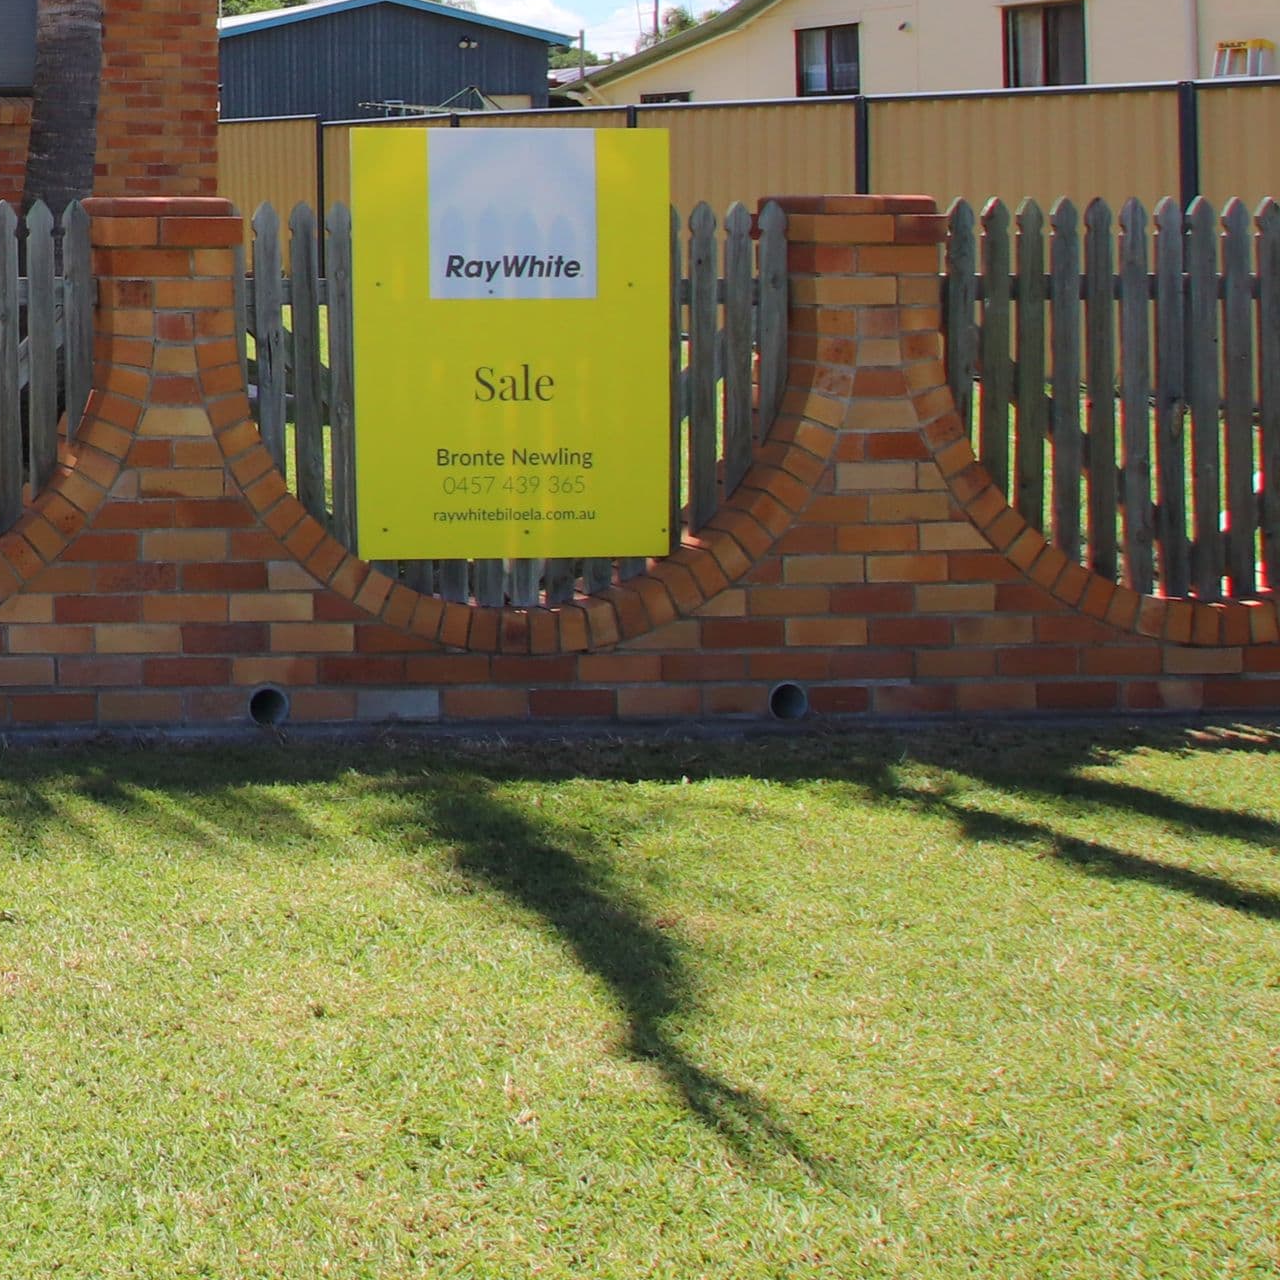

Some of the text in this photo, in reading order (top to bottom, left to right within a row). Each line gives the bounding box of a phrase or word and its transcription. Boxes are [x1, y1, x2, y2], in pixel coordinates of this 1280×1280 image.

[474, 364, 555, 402] Sale
[436, 448, 593, 469] Bronte Newling
[442, 475, 586, 495] 0457 439 365
[433, 508, 596, 523] raywhitebiloela.com.au
